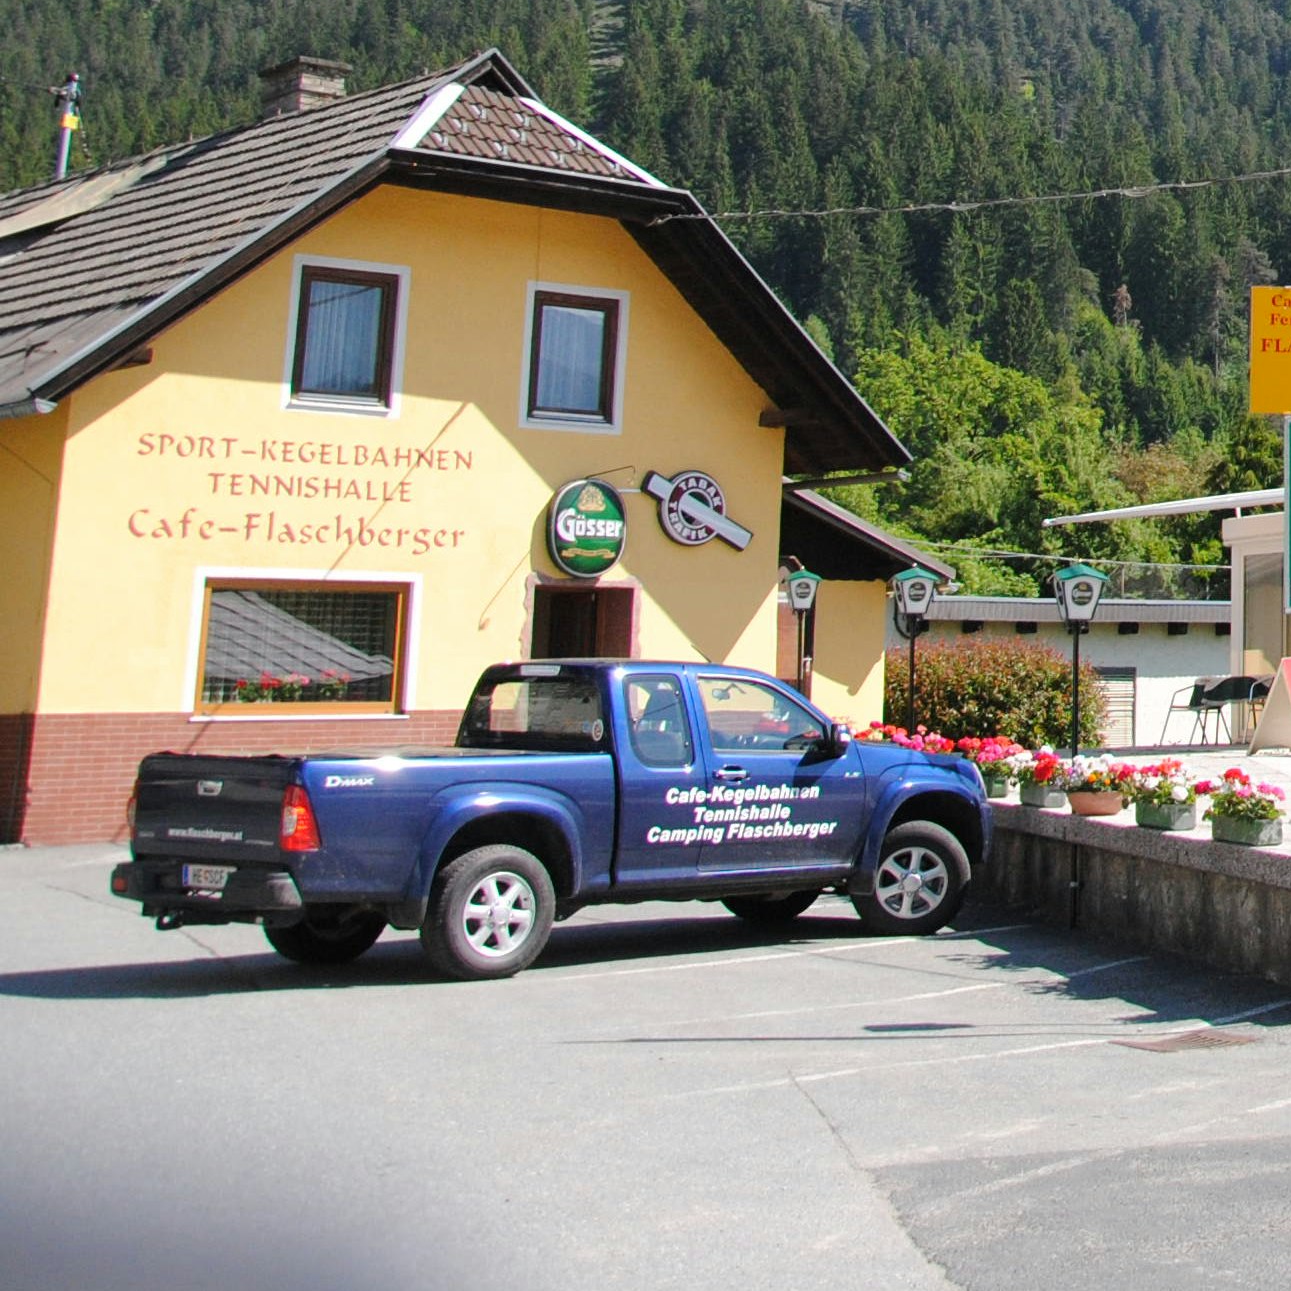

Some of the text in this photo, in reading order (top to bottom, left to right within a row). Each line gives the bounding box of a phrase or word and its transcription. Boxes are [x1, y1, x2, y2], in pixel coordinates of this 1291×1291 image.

[137, 433, 474, 470] SPORT-KEGELBAHNEN
[208, 473, 413, 503] TENNISHALLE
[680, 477, 722, 507] TABAK
[128, 507, 466, 555] Cafe-Flaschberger
[556, 507, 624, 543] Gösser
[668, 501, 708, 540] TRAFIK
[693, 804, 791, 823] Tennishalle
[647, 820, 837, 845] Camping Flaschberger
